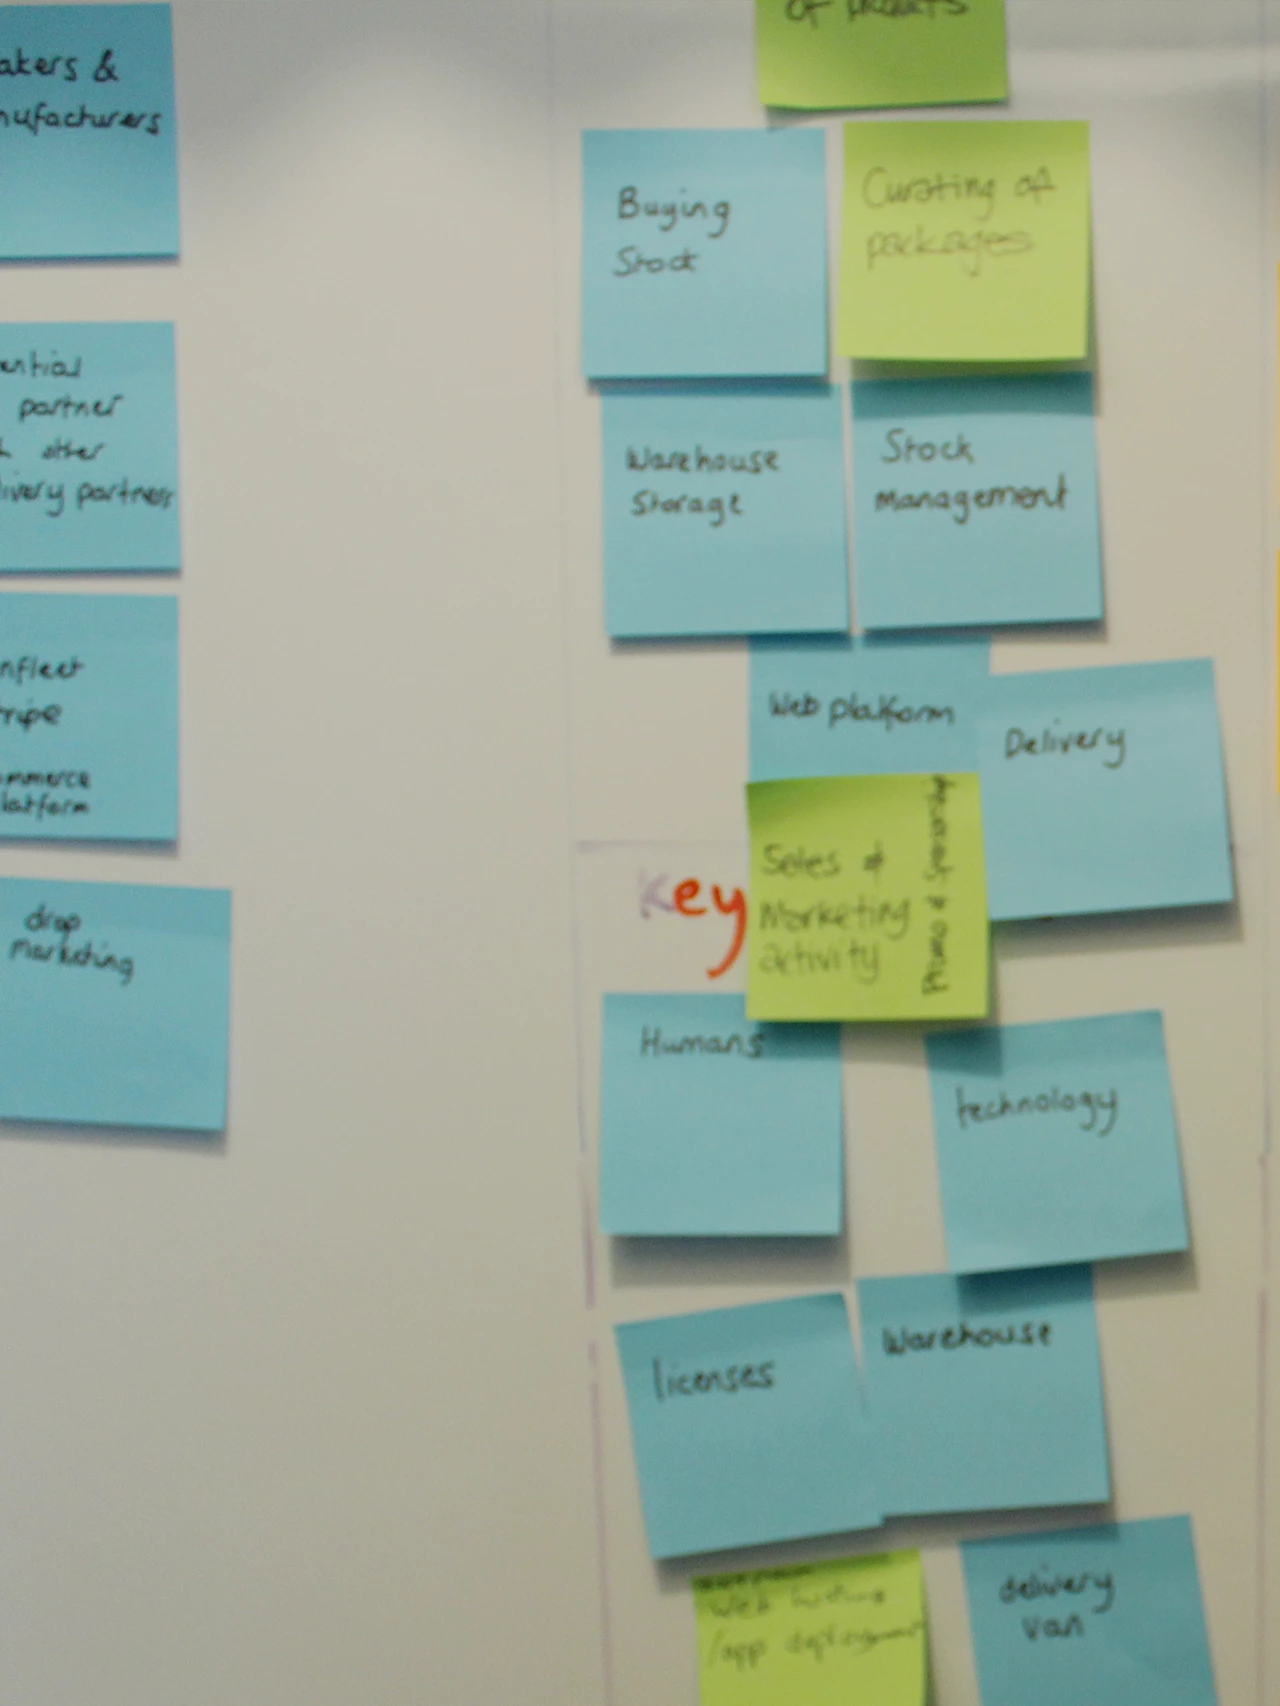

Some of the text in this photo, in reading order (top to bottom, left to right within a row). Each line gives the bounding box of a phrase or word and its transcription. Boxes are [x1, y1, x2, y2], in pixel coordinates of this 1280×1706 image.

[93, 49, 120, 82] &
[616, 185, 731, 239] Buying
[862, 165, 996, 221] Curating
[866, 224, 1035, 278] packages
[18, 393, 124, 424] partner
[626, 445, 780, 475] Warehouse
[881, 427, 975, 466] Stock
[0, 470, 66, 518] ivery
[631, 489, 744, 528] Storage
[875, 470, 1070, 525] management
[769, 691, 957, 732] Web platform
[1004, 717, 1128, 769] Delivery
[0, 769, 92, 791] mmerce
[759, 842, 841, 880] Sales
[638, 866, 749, 981] Key
[758, 895, 912, 941] Marketing
[758, 940, 882, 986] activity
[639, 1025, 767, 1059] Humans
[955, 1085, 1119, 1138] technology
[883, 1319, 1053, 1356] Warehouse
[652, 1358, 776, 1402] licenses
[1000, 1563, 1116, 1614] delivery
[1023, 1613, 1084, 1642] van
